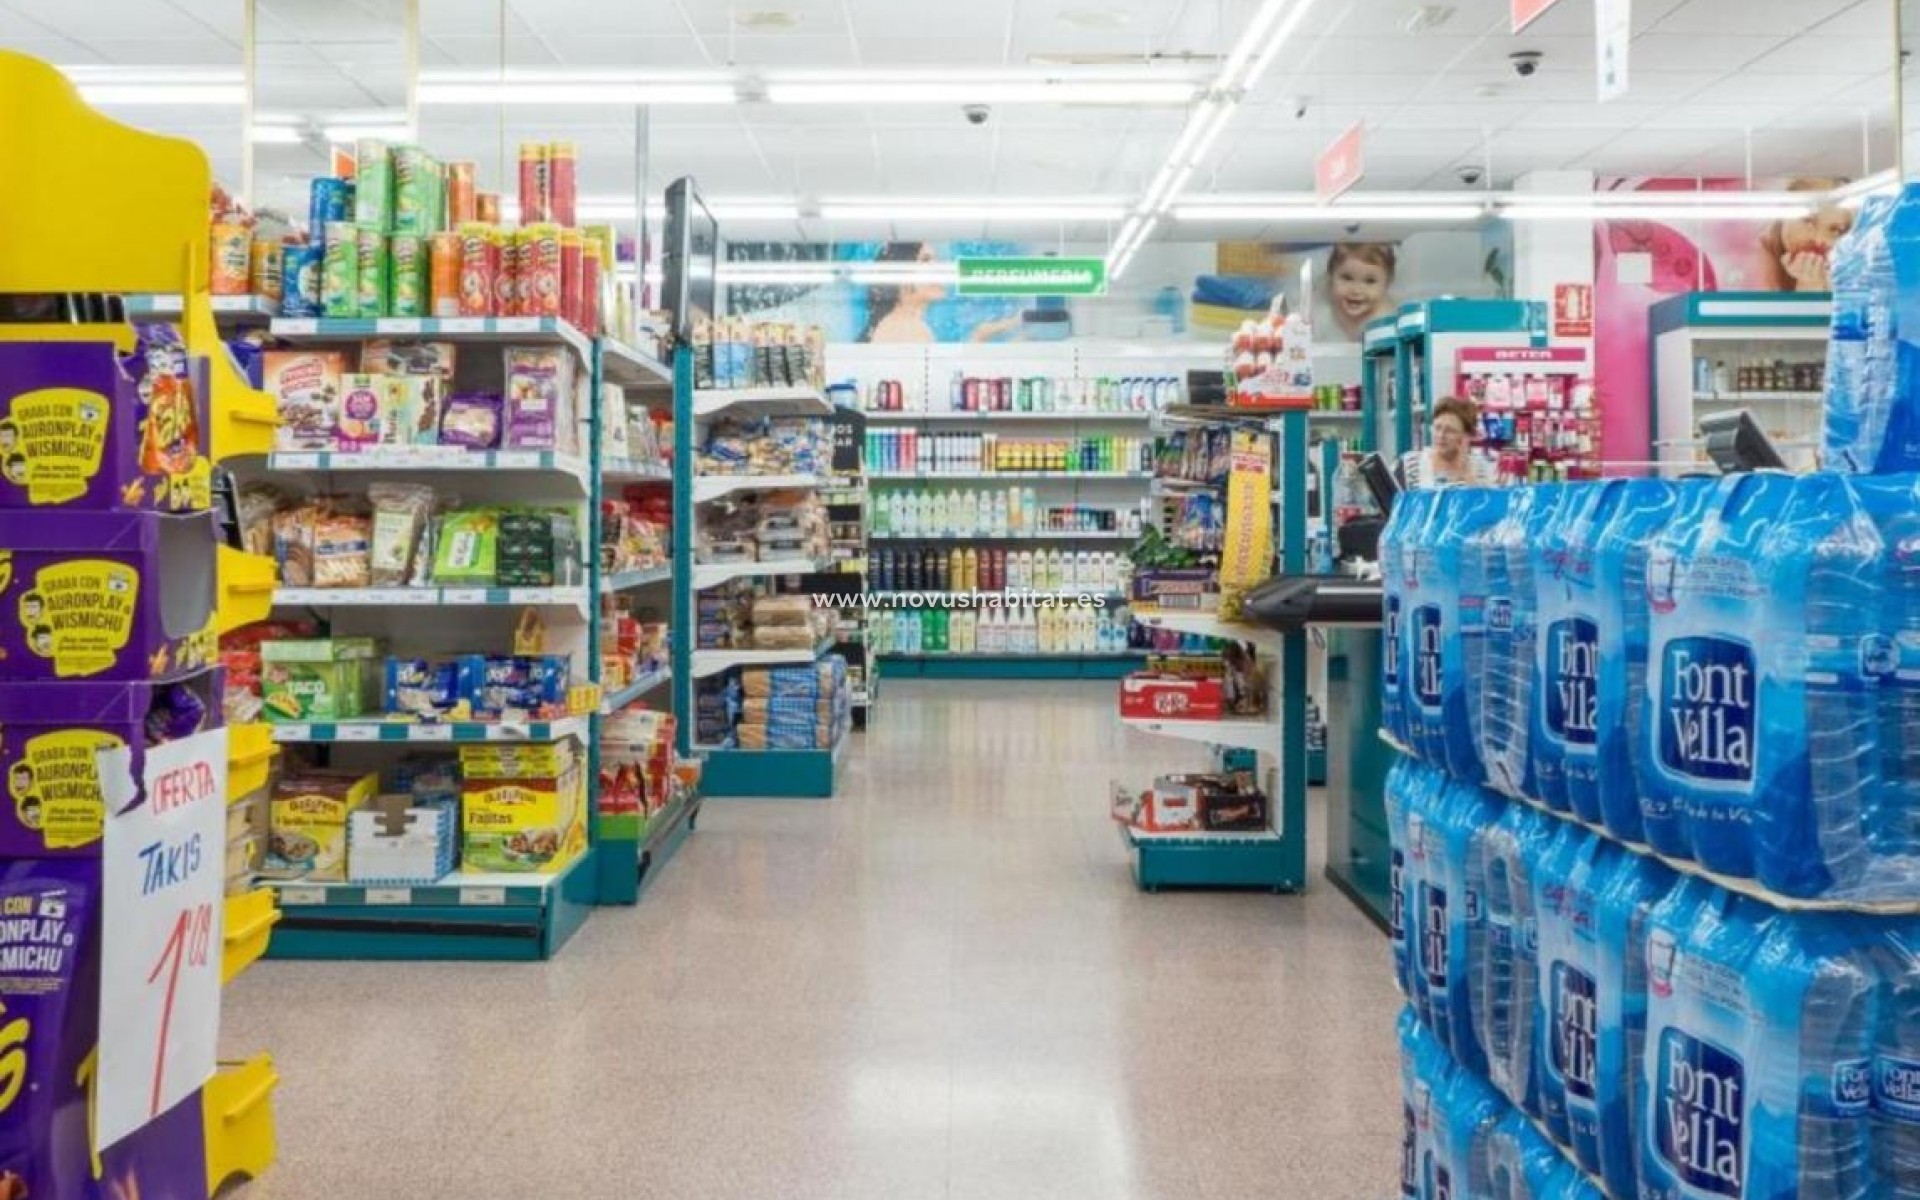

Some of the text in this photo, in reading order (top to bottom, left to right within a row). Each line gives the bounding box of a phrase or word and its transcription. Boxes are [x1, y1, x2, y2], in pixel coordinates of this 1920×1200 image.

[21, 420, 97, 440] AURONPLAY
[26, 439, 95, 461] WISMICHU
[47, 591, 123, 611] AURONPLAY
[51, 611, 124, 633] WISMICHU
[1671, 649, 1750, 709] Font
[1671, 706, 1750, 768] Vella
[138, 832, 201, 896] TAKIS
